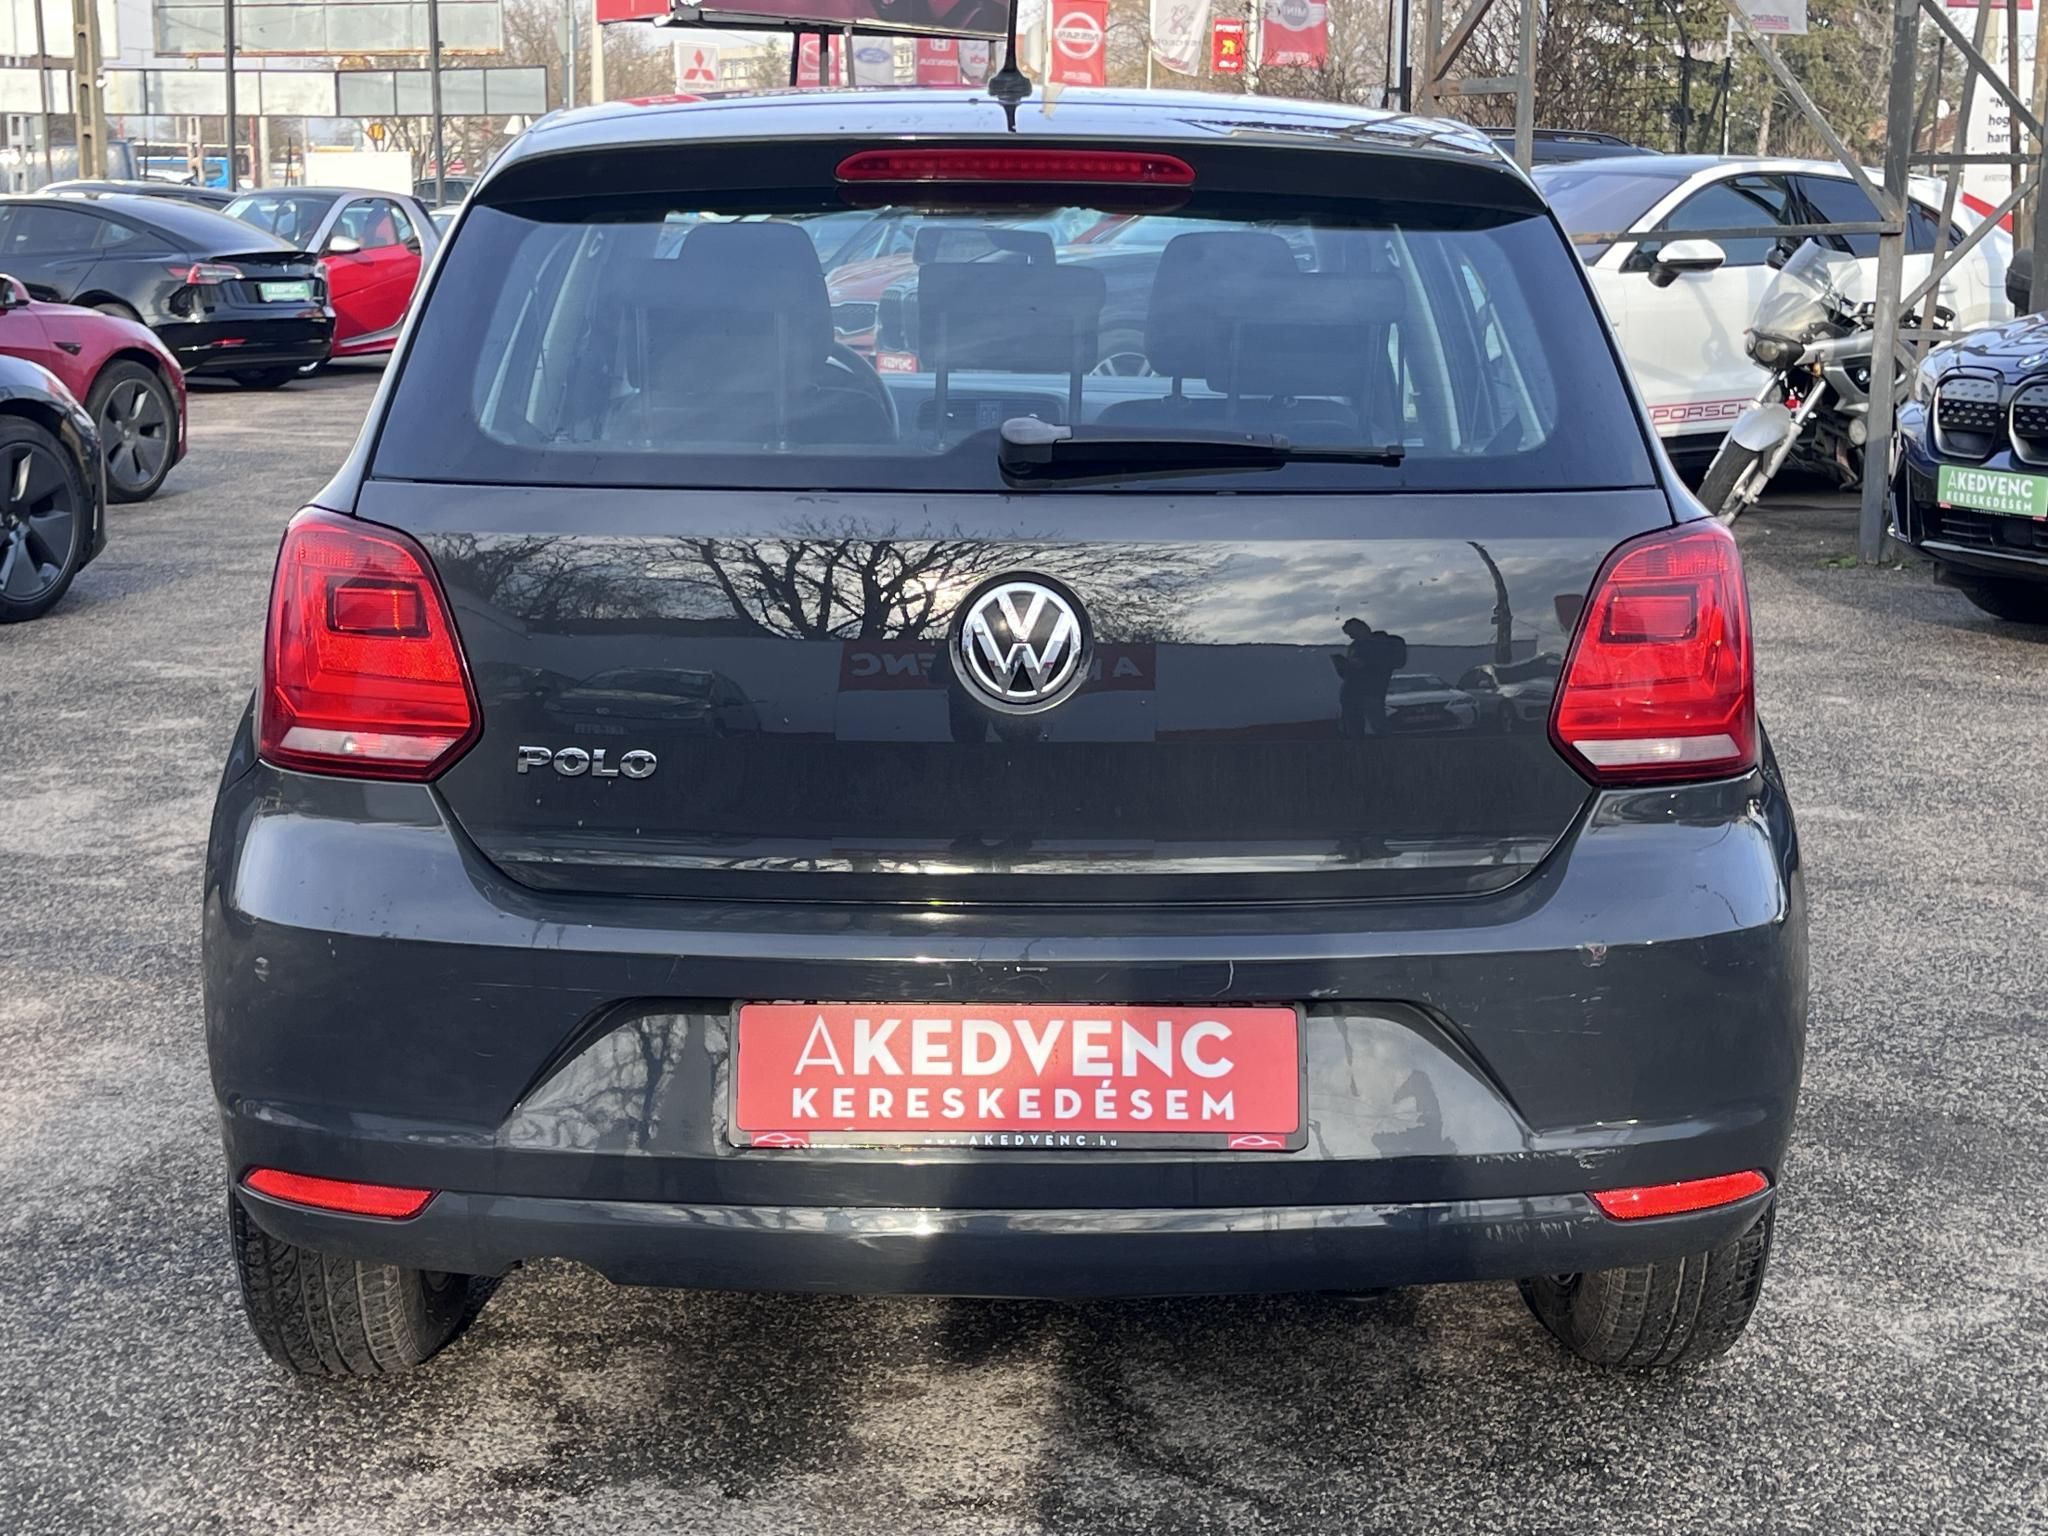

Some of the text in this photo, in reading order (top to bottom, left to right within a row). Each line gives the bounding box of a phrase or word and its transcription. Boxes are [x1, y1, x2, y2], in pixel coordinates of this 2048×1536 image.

[1947, 470, 2033, 498] AKEDVENC
[517, 745, 657, 779] POLO
[794, 1013, 1235, 1078] AKEDVENC
[792, 1081, 1236, 1121] KERESKEDÉSEM
[924, 1134, 1118, 1147] www.AKEDVENC.hu
